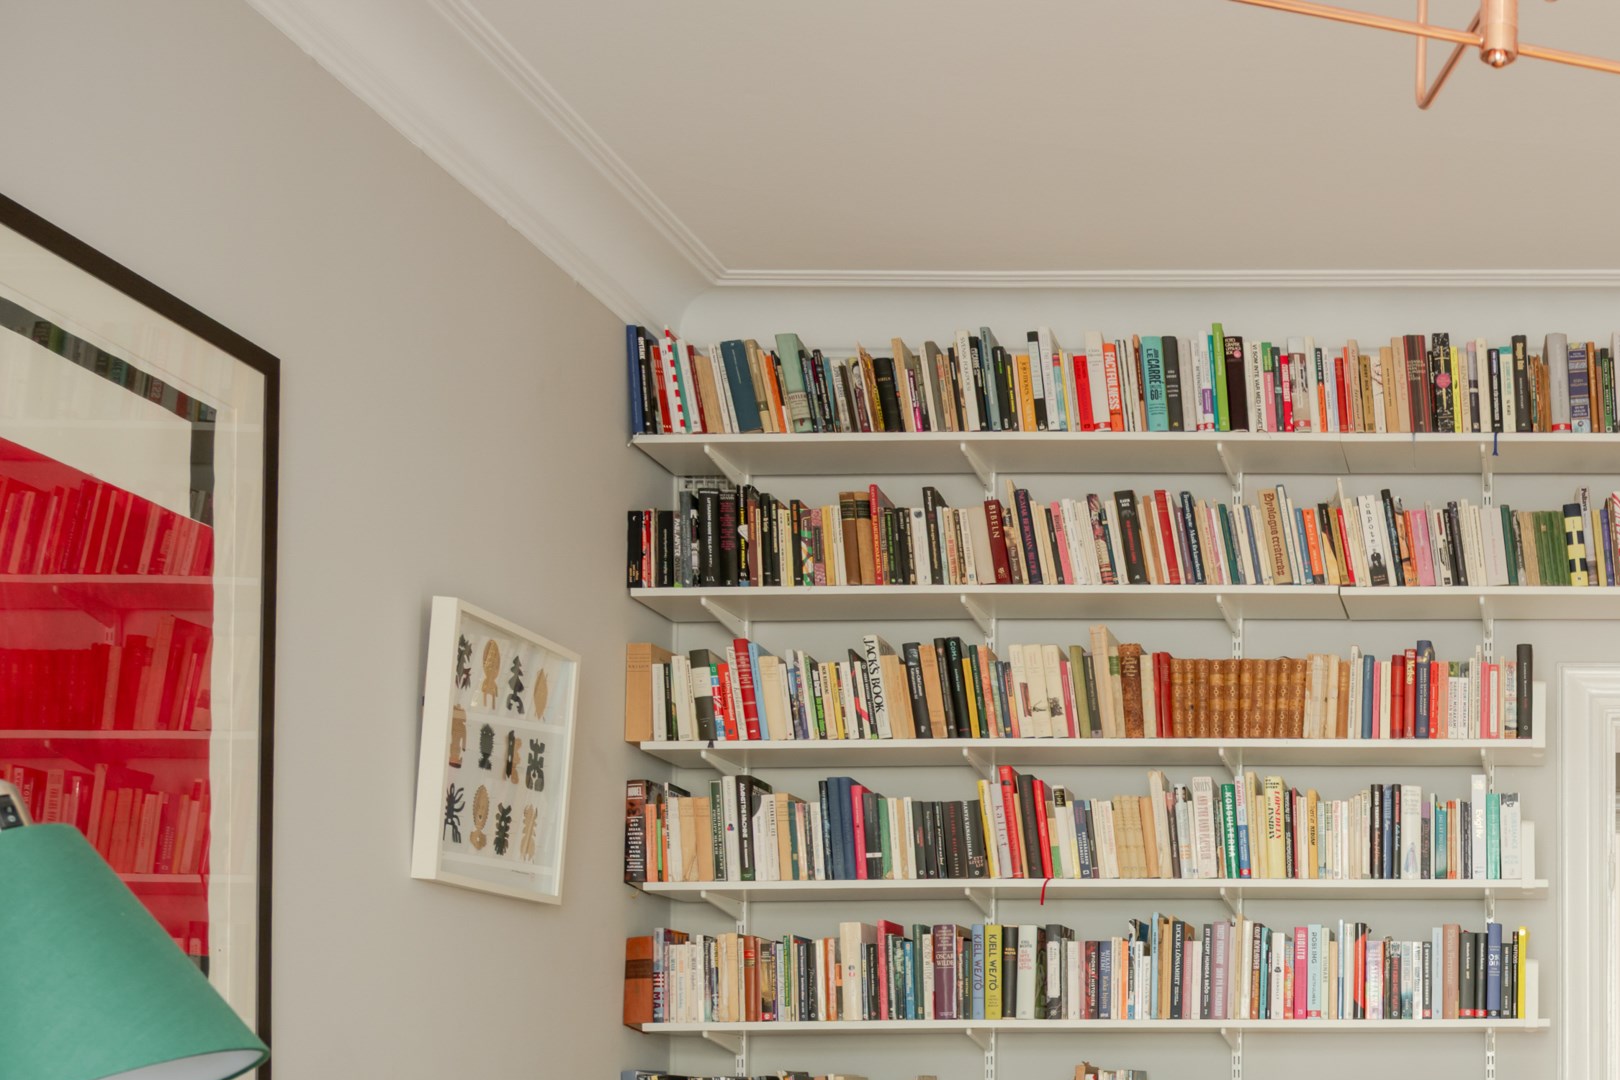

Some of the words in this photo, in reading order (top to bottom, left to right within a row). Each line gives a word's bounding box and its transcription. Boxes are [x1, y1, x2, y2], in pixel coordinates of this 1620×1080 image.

[1105, 351, 1120, 410] FACTFULNESS
[1148, 358, 1163, 384] CARRÉ
[1018, 490, 1029, 516] INGMAR
[988, 504, 1000, 538] BIBELN
[1022, 518, 1035, 550] BERGMAN
[864, 638, 881, 675] JACK'S
[872, 678, 884, 712] BOOK
[995, 805, 1007, 848] kallet
[1224, 791, 1236, 858] KONSULTERNA
[1474, 808, 1484, 827] Evigt
[973, 934, 982, 957] KJELL
[988, 934, 998, 957] KJELL
